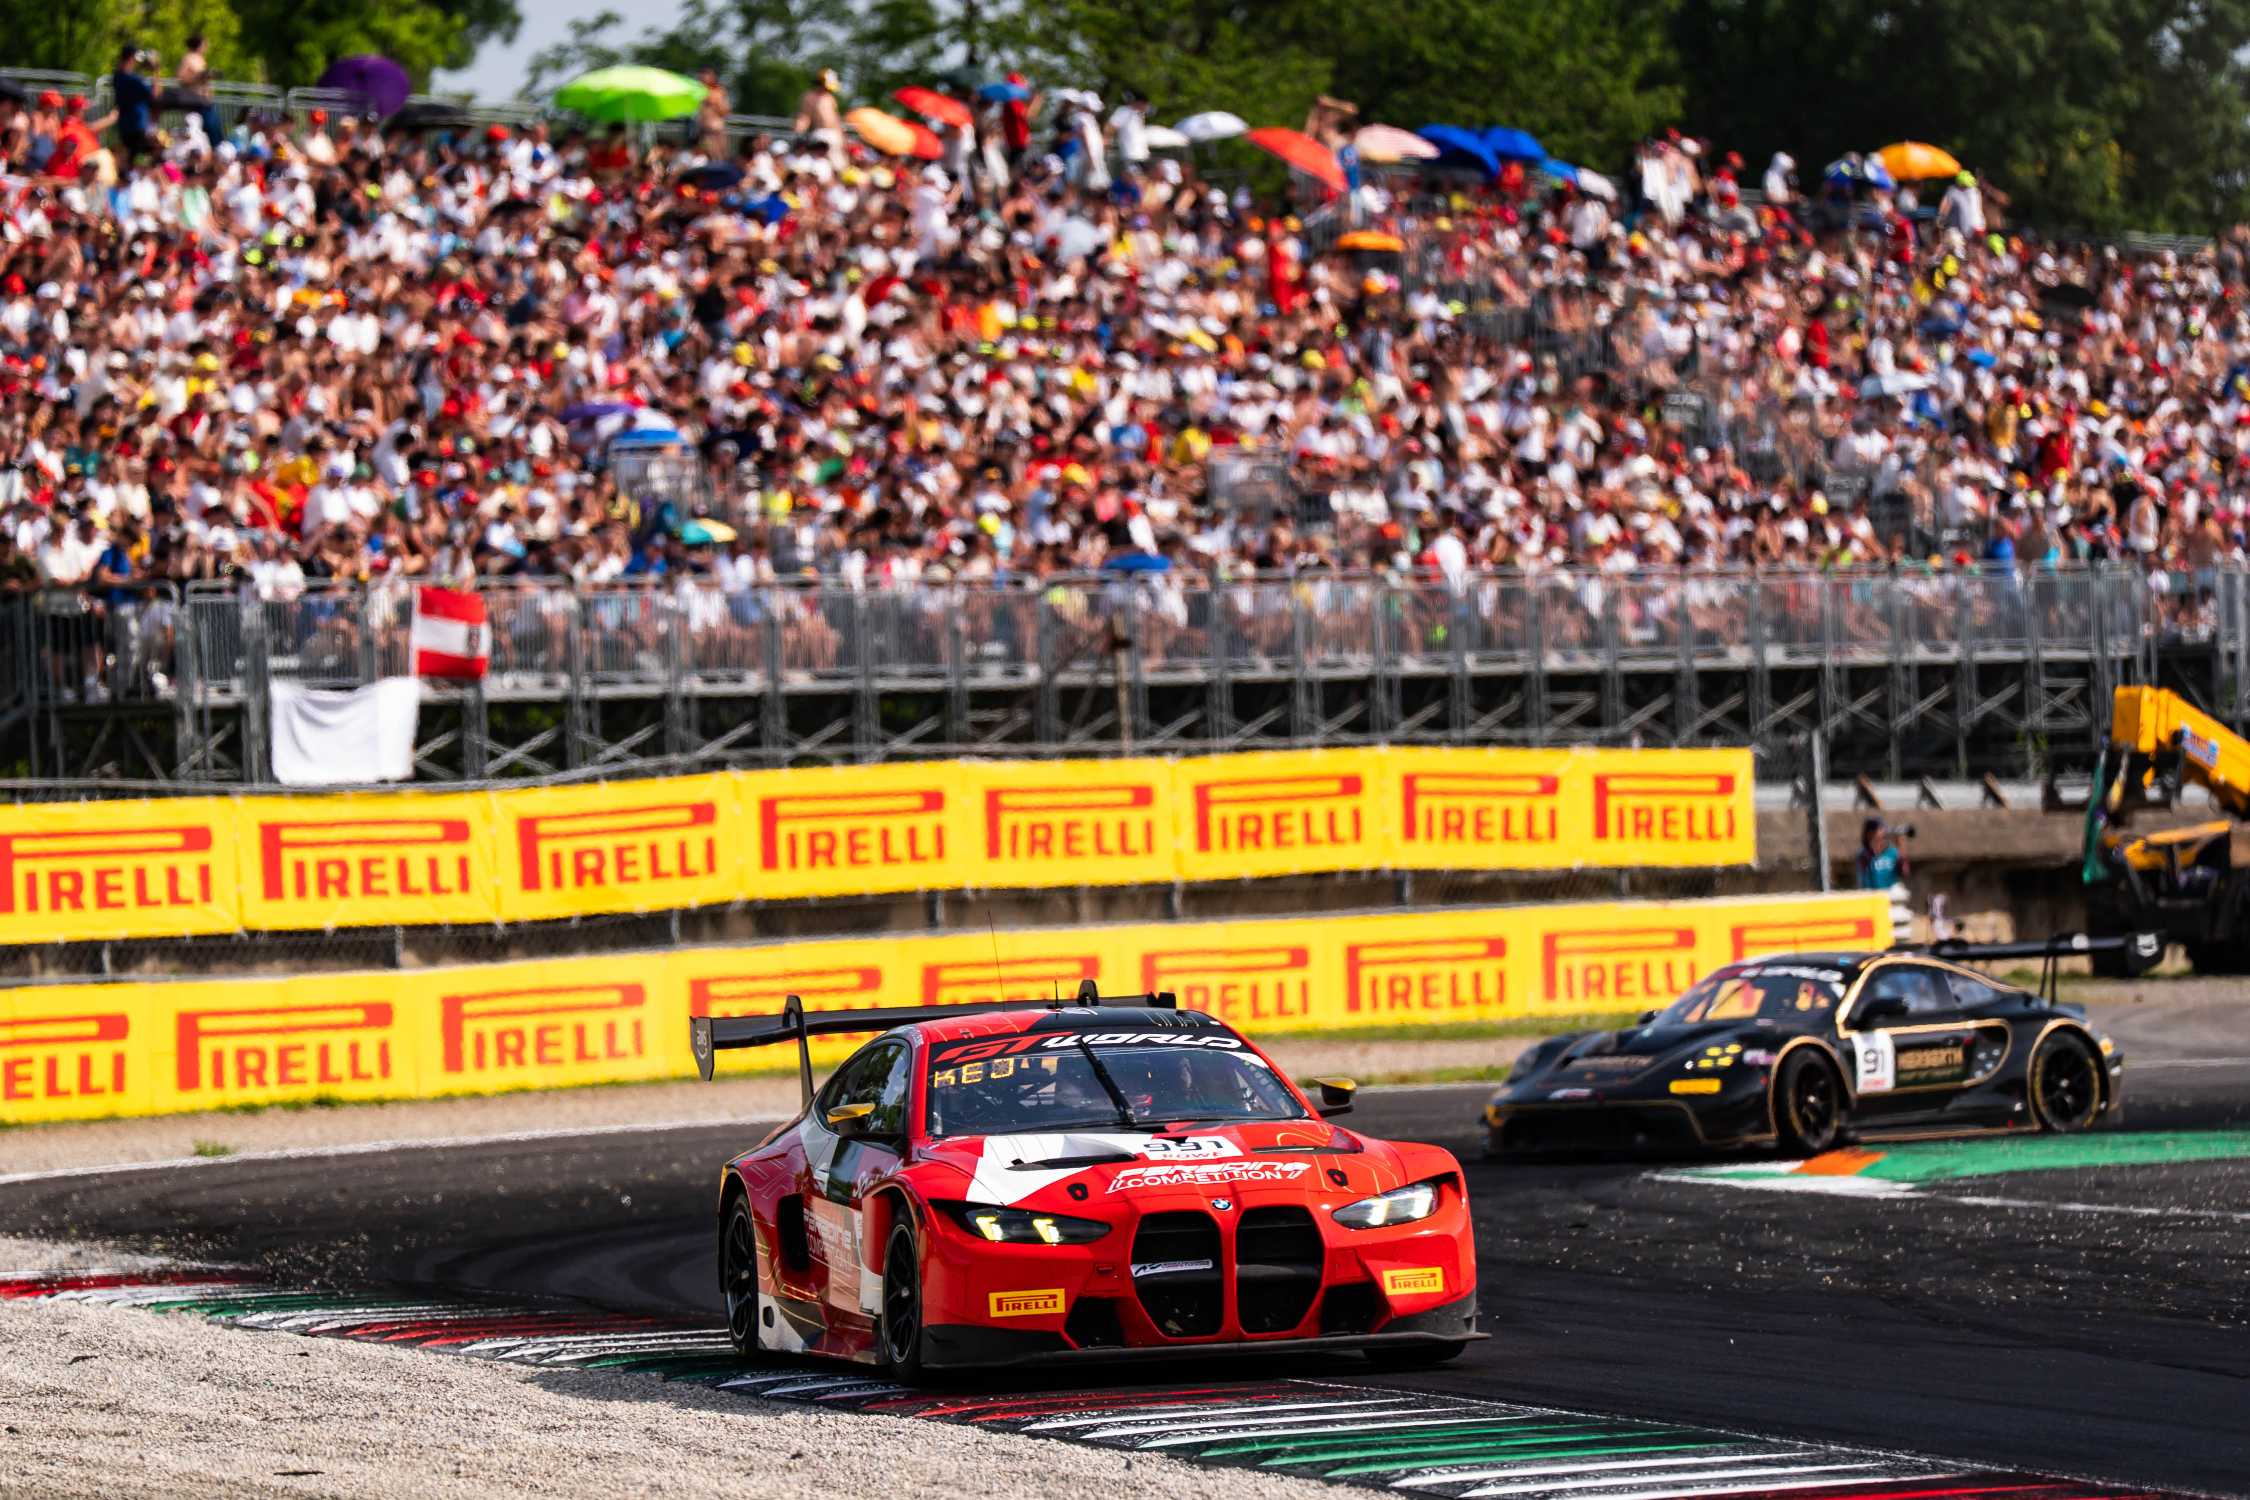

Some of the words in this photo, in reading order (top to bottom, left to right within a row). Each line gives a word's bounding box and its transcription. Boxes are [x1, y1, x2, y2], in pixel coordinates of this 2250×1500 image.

[760, 790, 945, 870] PIRELLI
[985, 786, 1153, 859] PIRELLI
[1194, 774, 1363, 852] PIRELLI
[1402, 773, 1559, 841] PIRELLI
[1594, 774, 1734, 840] PIRELLI
[0, 826, 212, 914] PIRELLI
[259, 819, 470, 900] PIRELLI
[517, 802, 716, 891] PIRELLI
[1142, 947, 1308, 1019] PRELLI
[1346, 938, 1506, 1012] PIRELLI
[1543, 928, 1696, 1000] PIRELLI
[0, 1014, 129, 1100] ELLI
[176, 1002, 393, 1091] PIRELLI
[442, 984, 644, 1072] PIRELLI
[933, 1031, 1073, 1063] GT
[1041, 1033, 1242, 1049] WORLD
[1863, 1050, 1885, 1073] 91
[1126, 1169, 1284, 1187] COMPETITION
[1143, 1138, 1224, 1152] 991
[996, 1294, 1058, 1312] PIRELLI
[1390, 1272, 1437, 1289] PIRELLI
